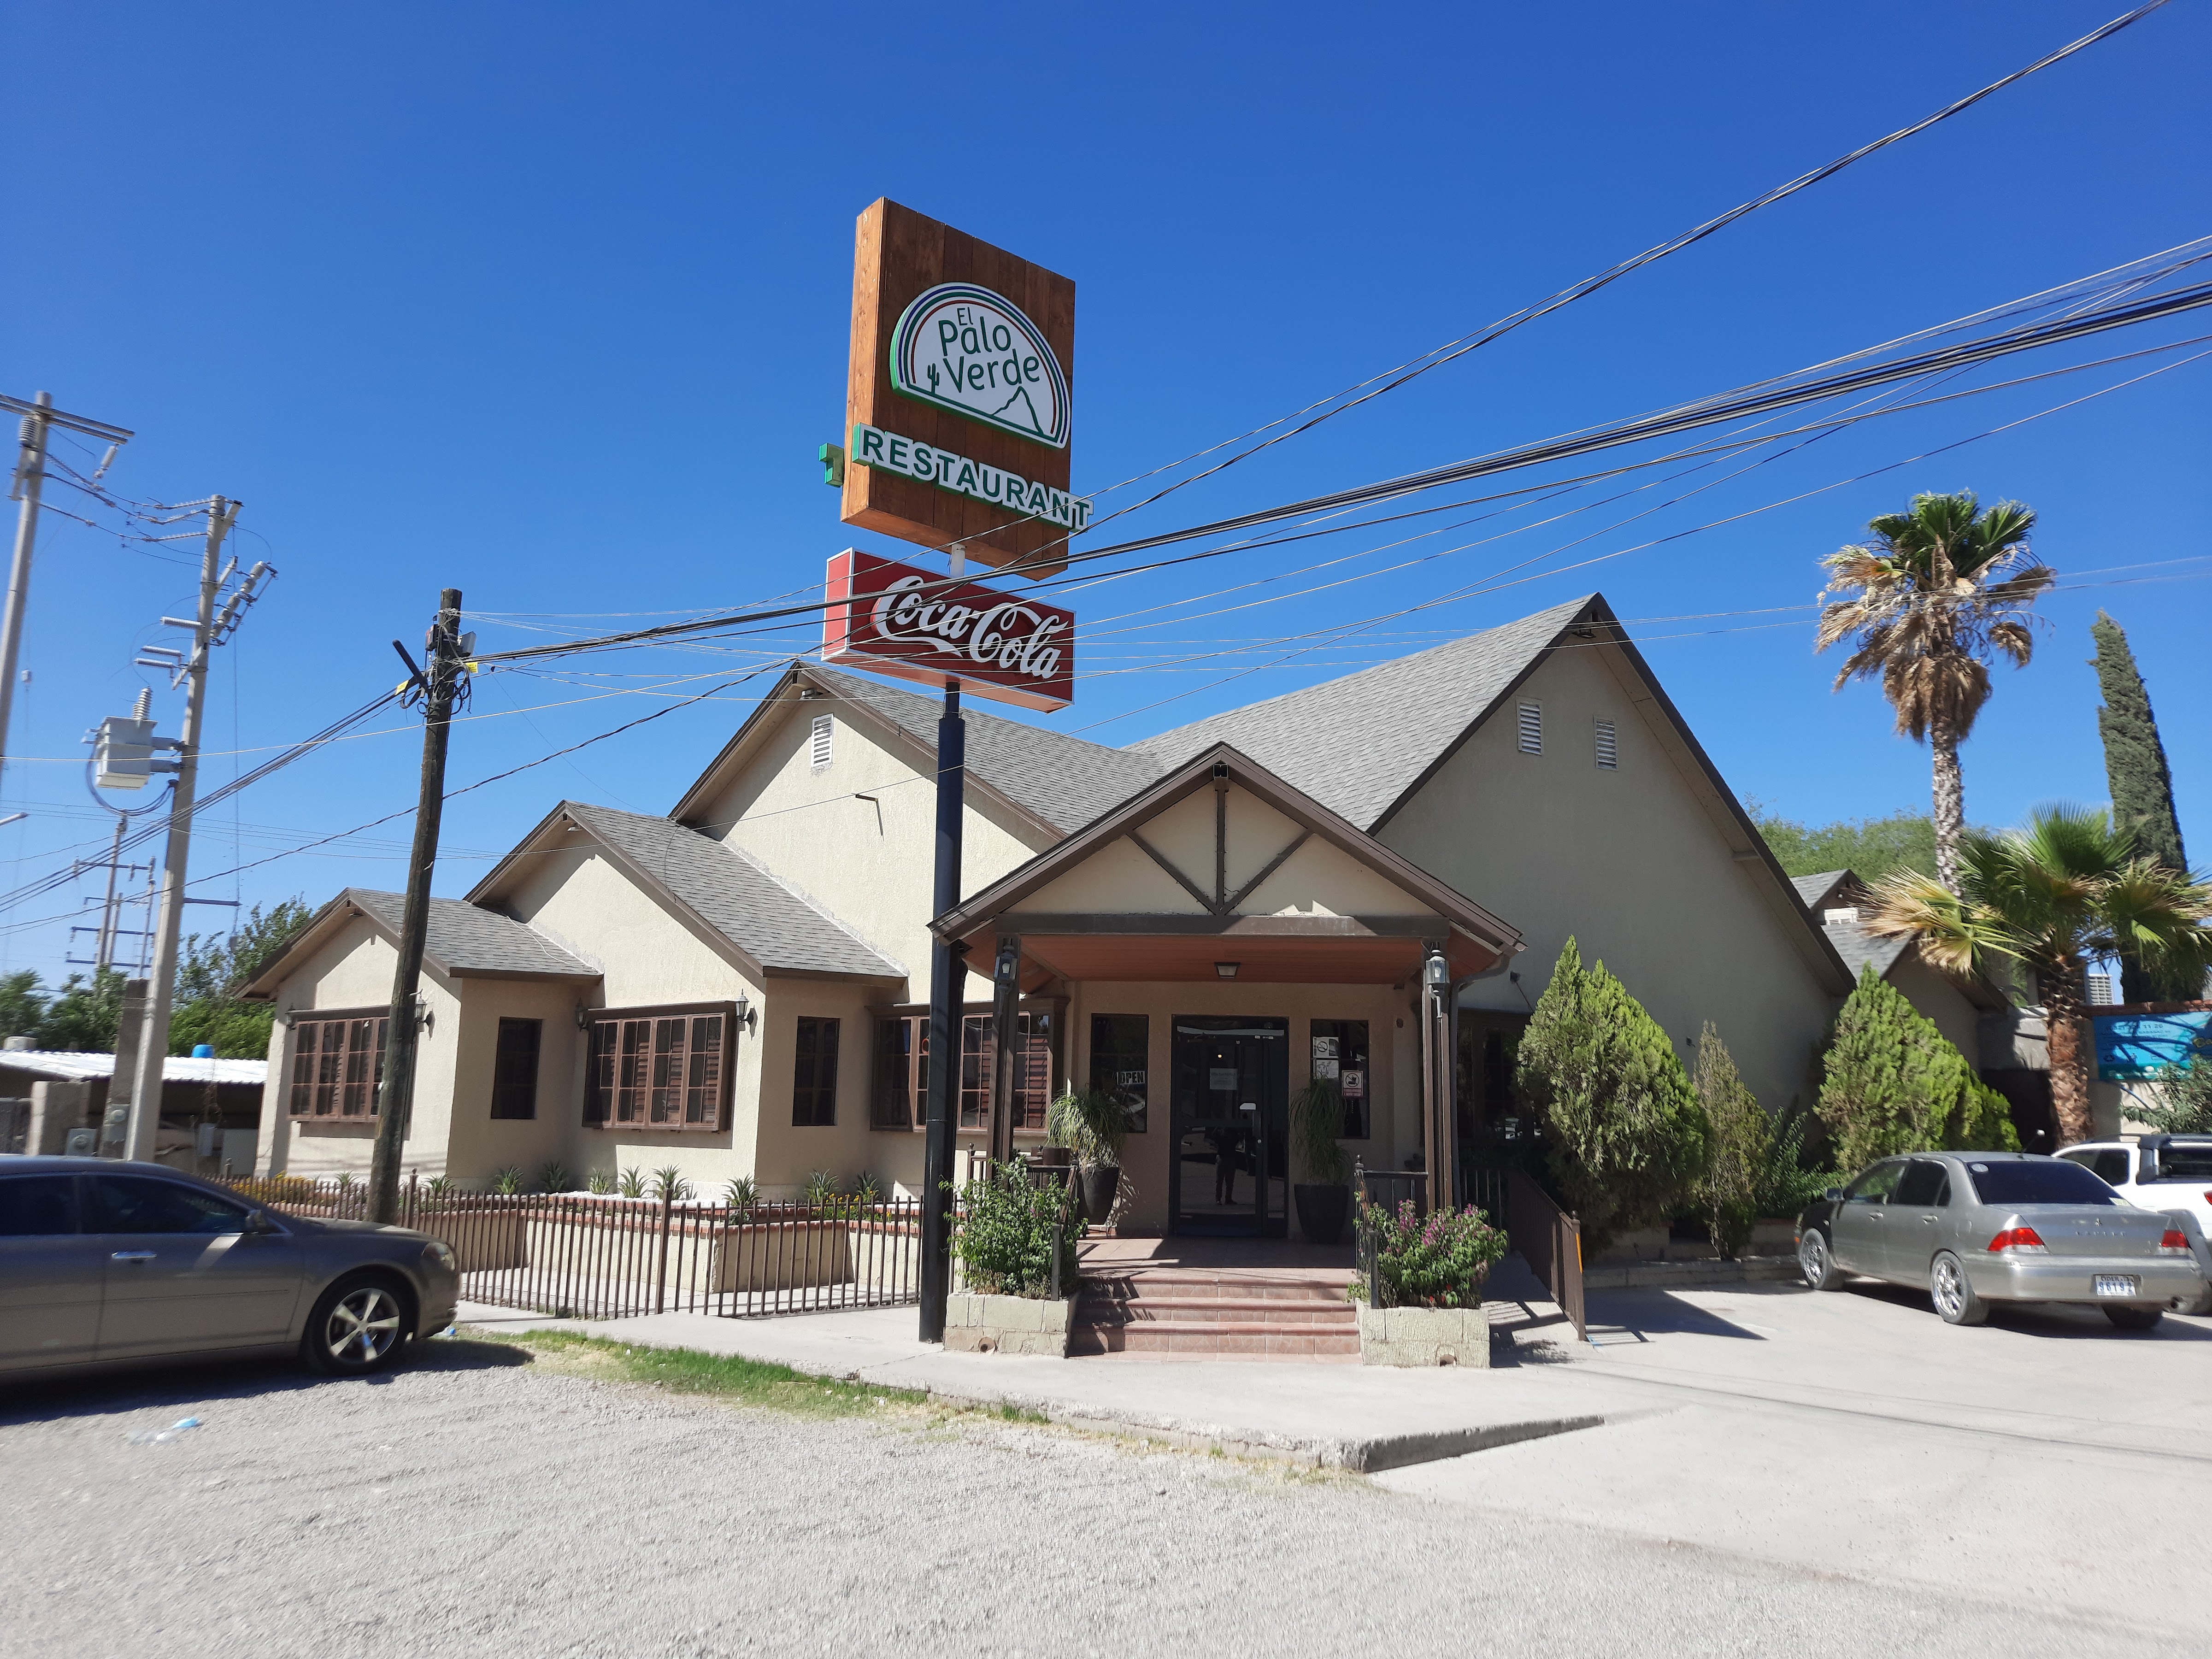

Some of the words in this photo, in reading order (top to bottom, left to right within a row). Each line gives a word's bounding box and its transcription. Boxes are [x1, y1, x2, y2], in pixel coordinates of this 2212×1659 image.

[939, 316, 1011, 356] Palo
[957, 306, 973, 326] El
[943, 348, 1040, 393] Verde
[863, 429, 1090, 527] RESTAURANT
[1118, 1072, 1144, 1084] OPEN
